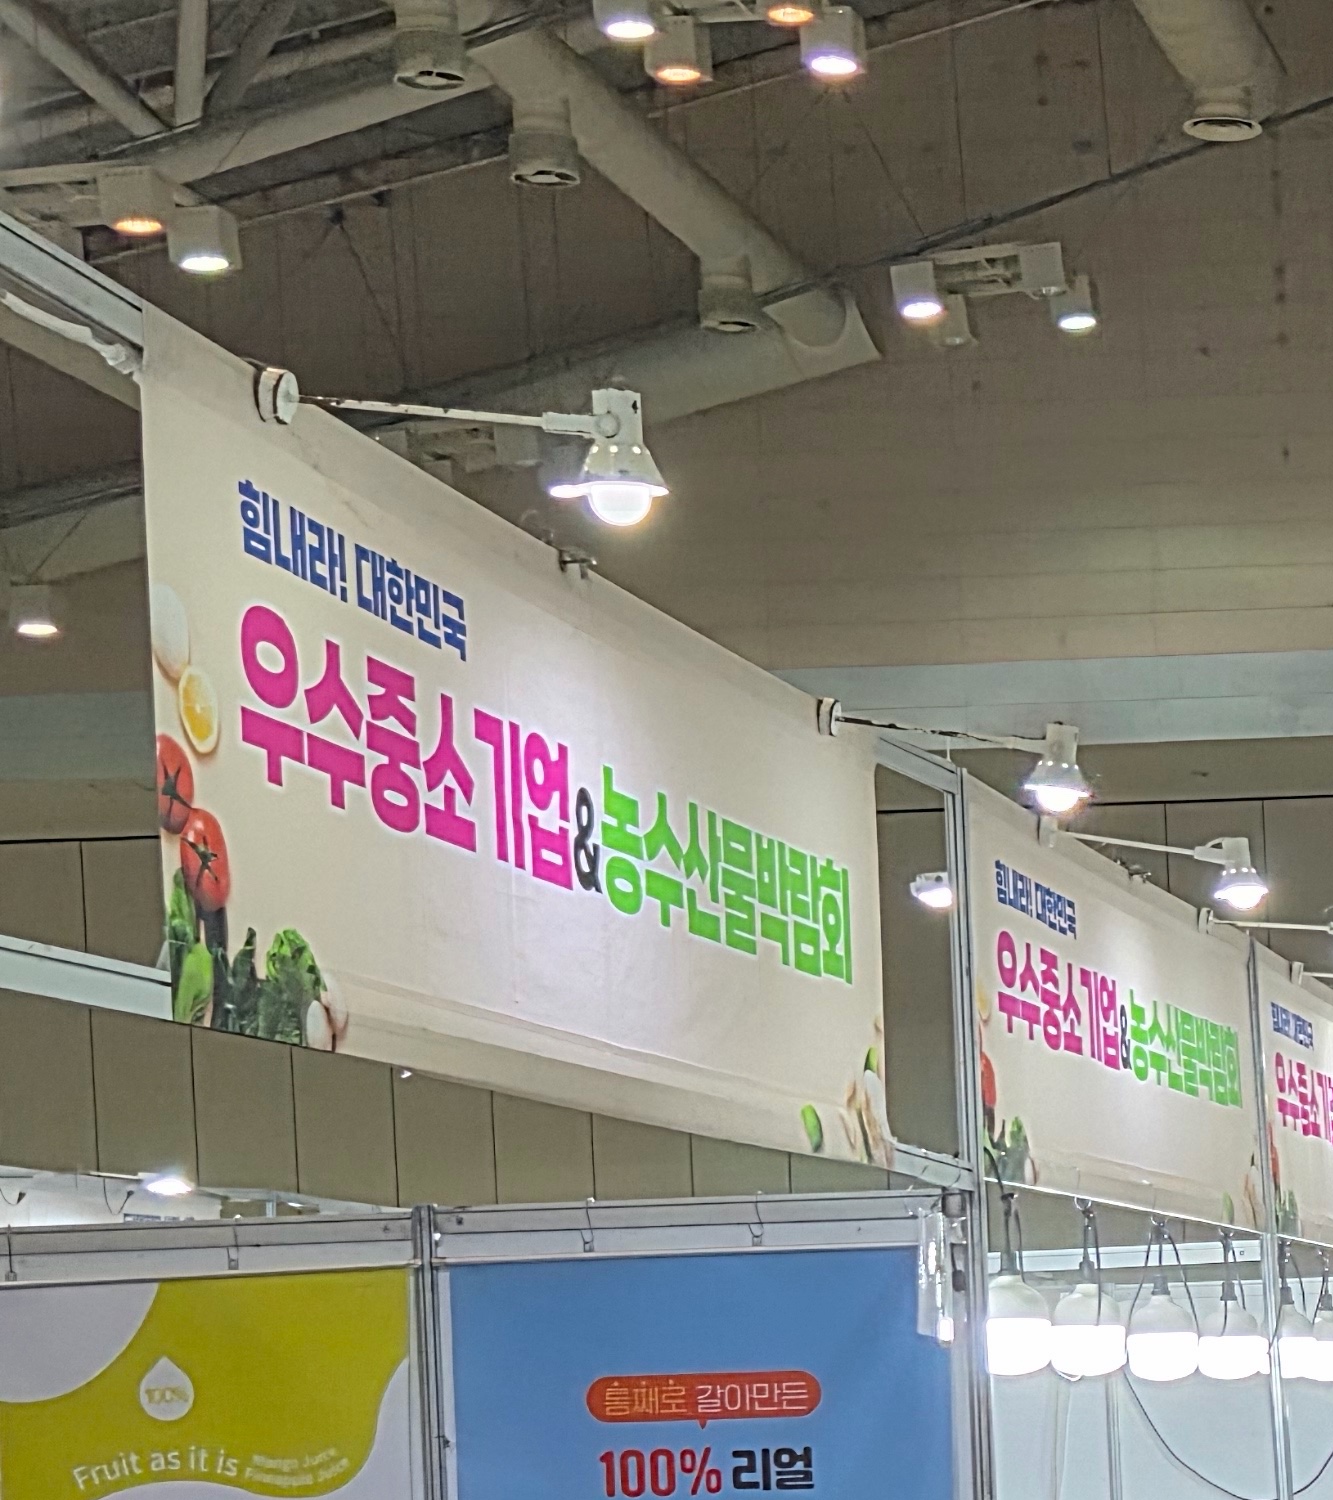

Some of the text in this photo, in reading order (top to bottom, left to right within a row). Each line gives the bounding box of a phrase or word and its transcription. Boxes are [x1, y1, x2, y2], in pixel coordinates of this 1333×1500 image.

[238, 478, 467, 661] 힘내라! 대한민국
[72, 1446, 239, 1491] Fruit as it is
[599, 1446, 815, 1498] 100% 리얼
